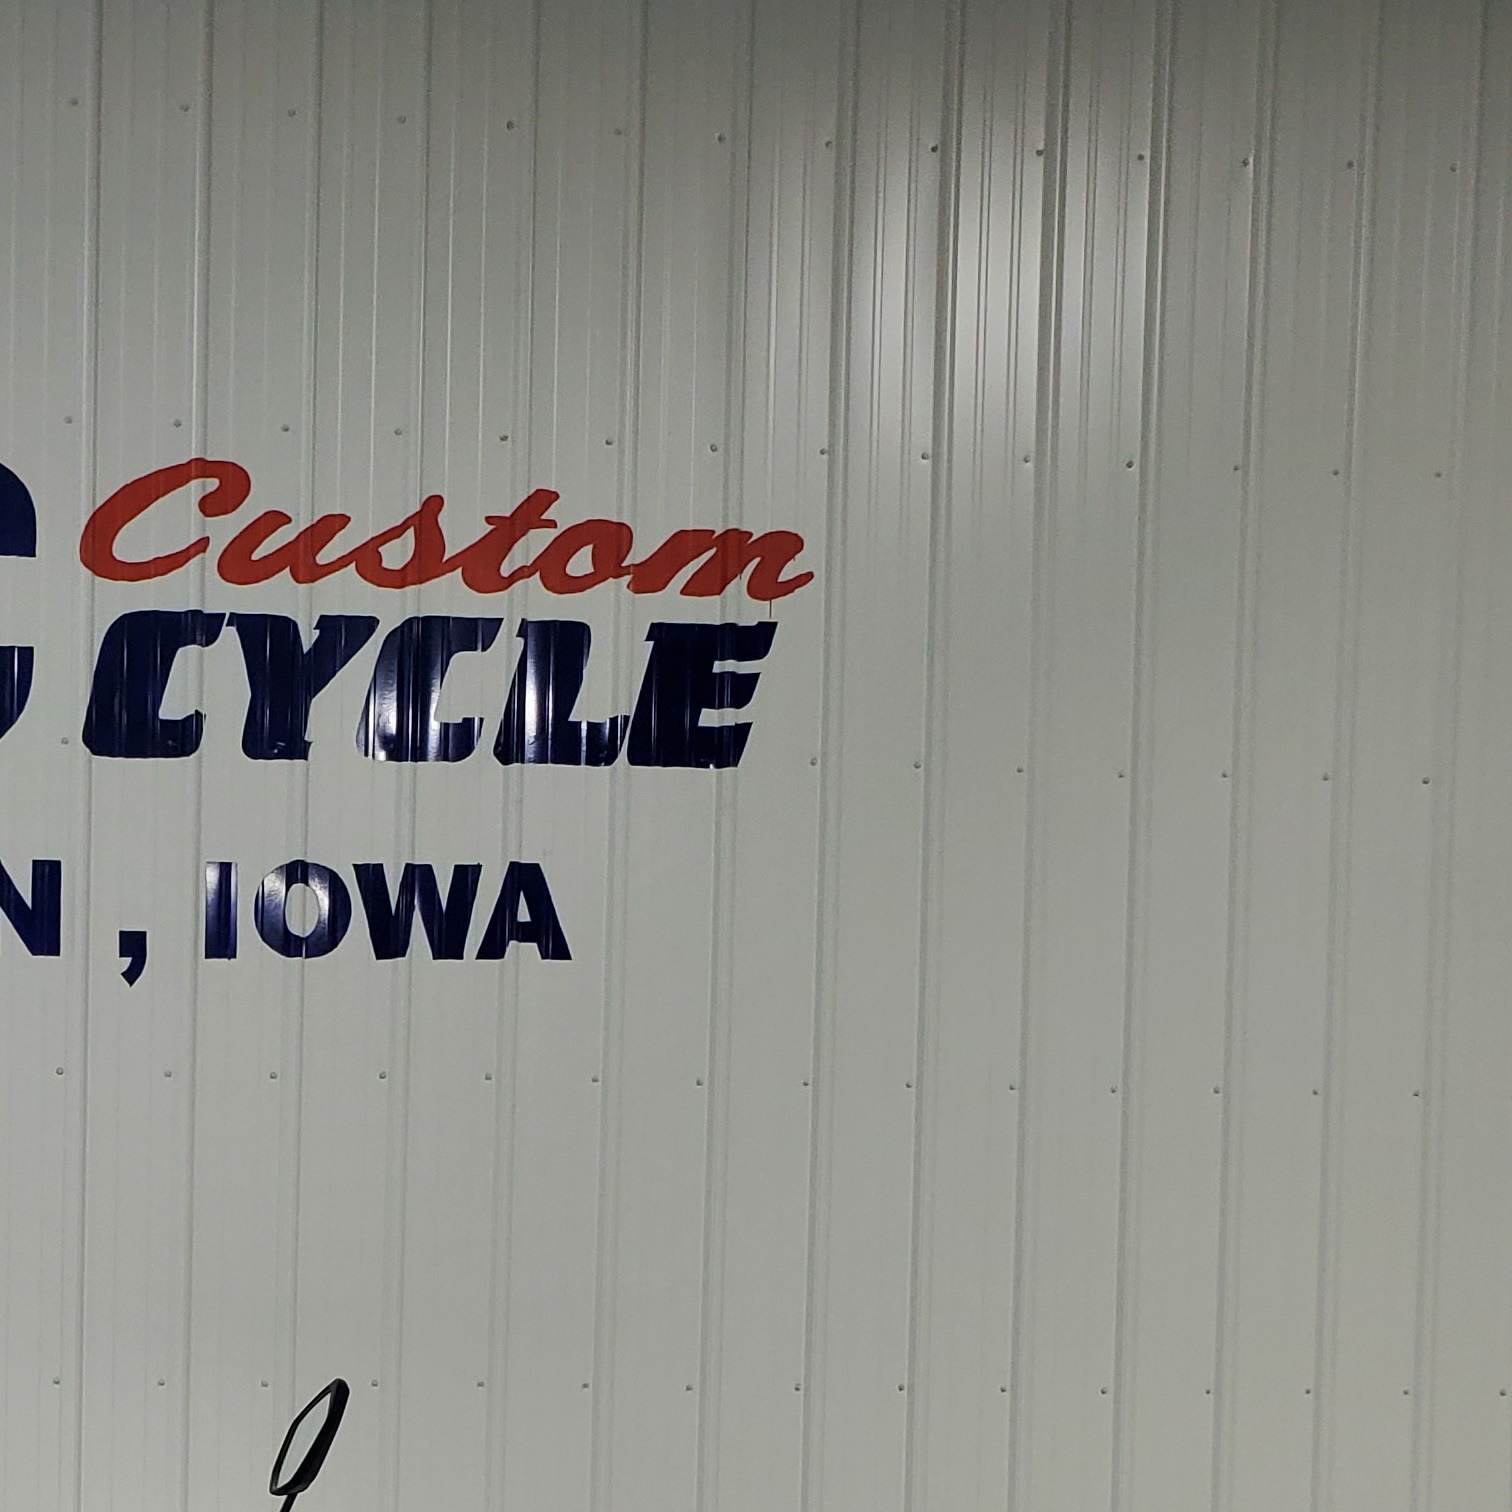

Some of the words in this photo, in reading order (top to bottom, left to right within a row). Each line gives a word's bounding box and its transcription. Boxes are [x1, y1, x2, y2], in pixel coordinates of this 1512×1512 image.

[80, 458, 813, 601] Custom
[81, 609, 778, 769] CYCLE
[205, 860, 573, 961] IOWA
